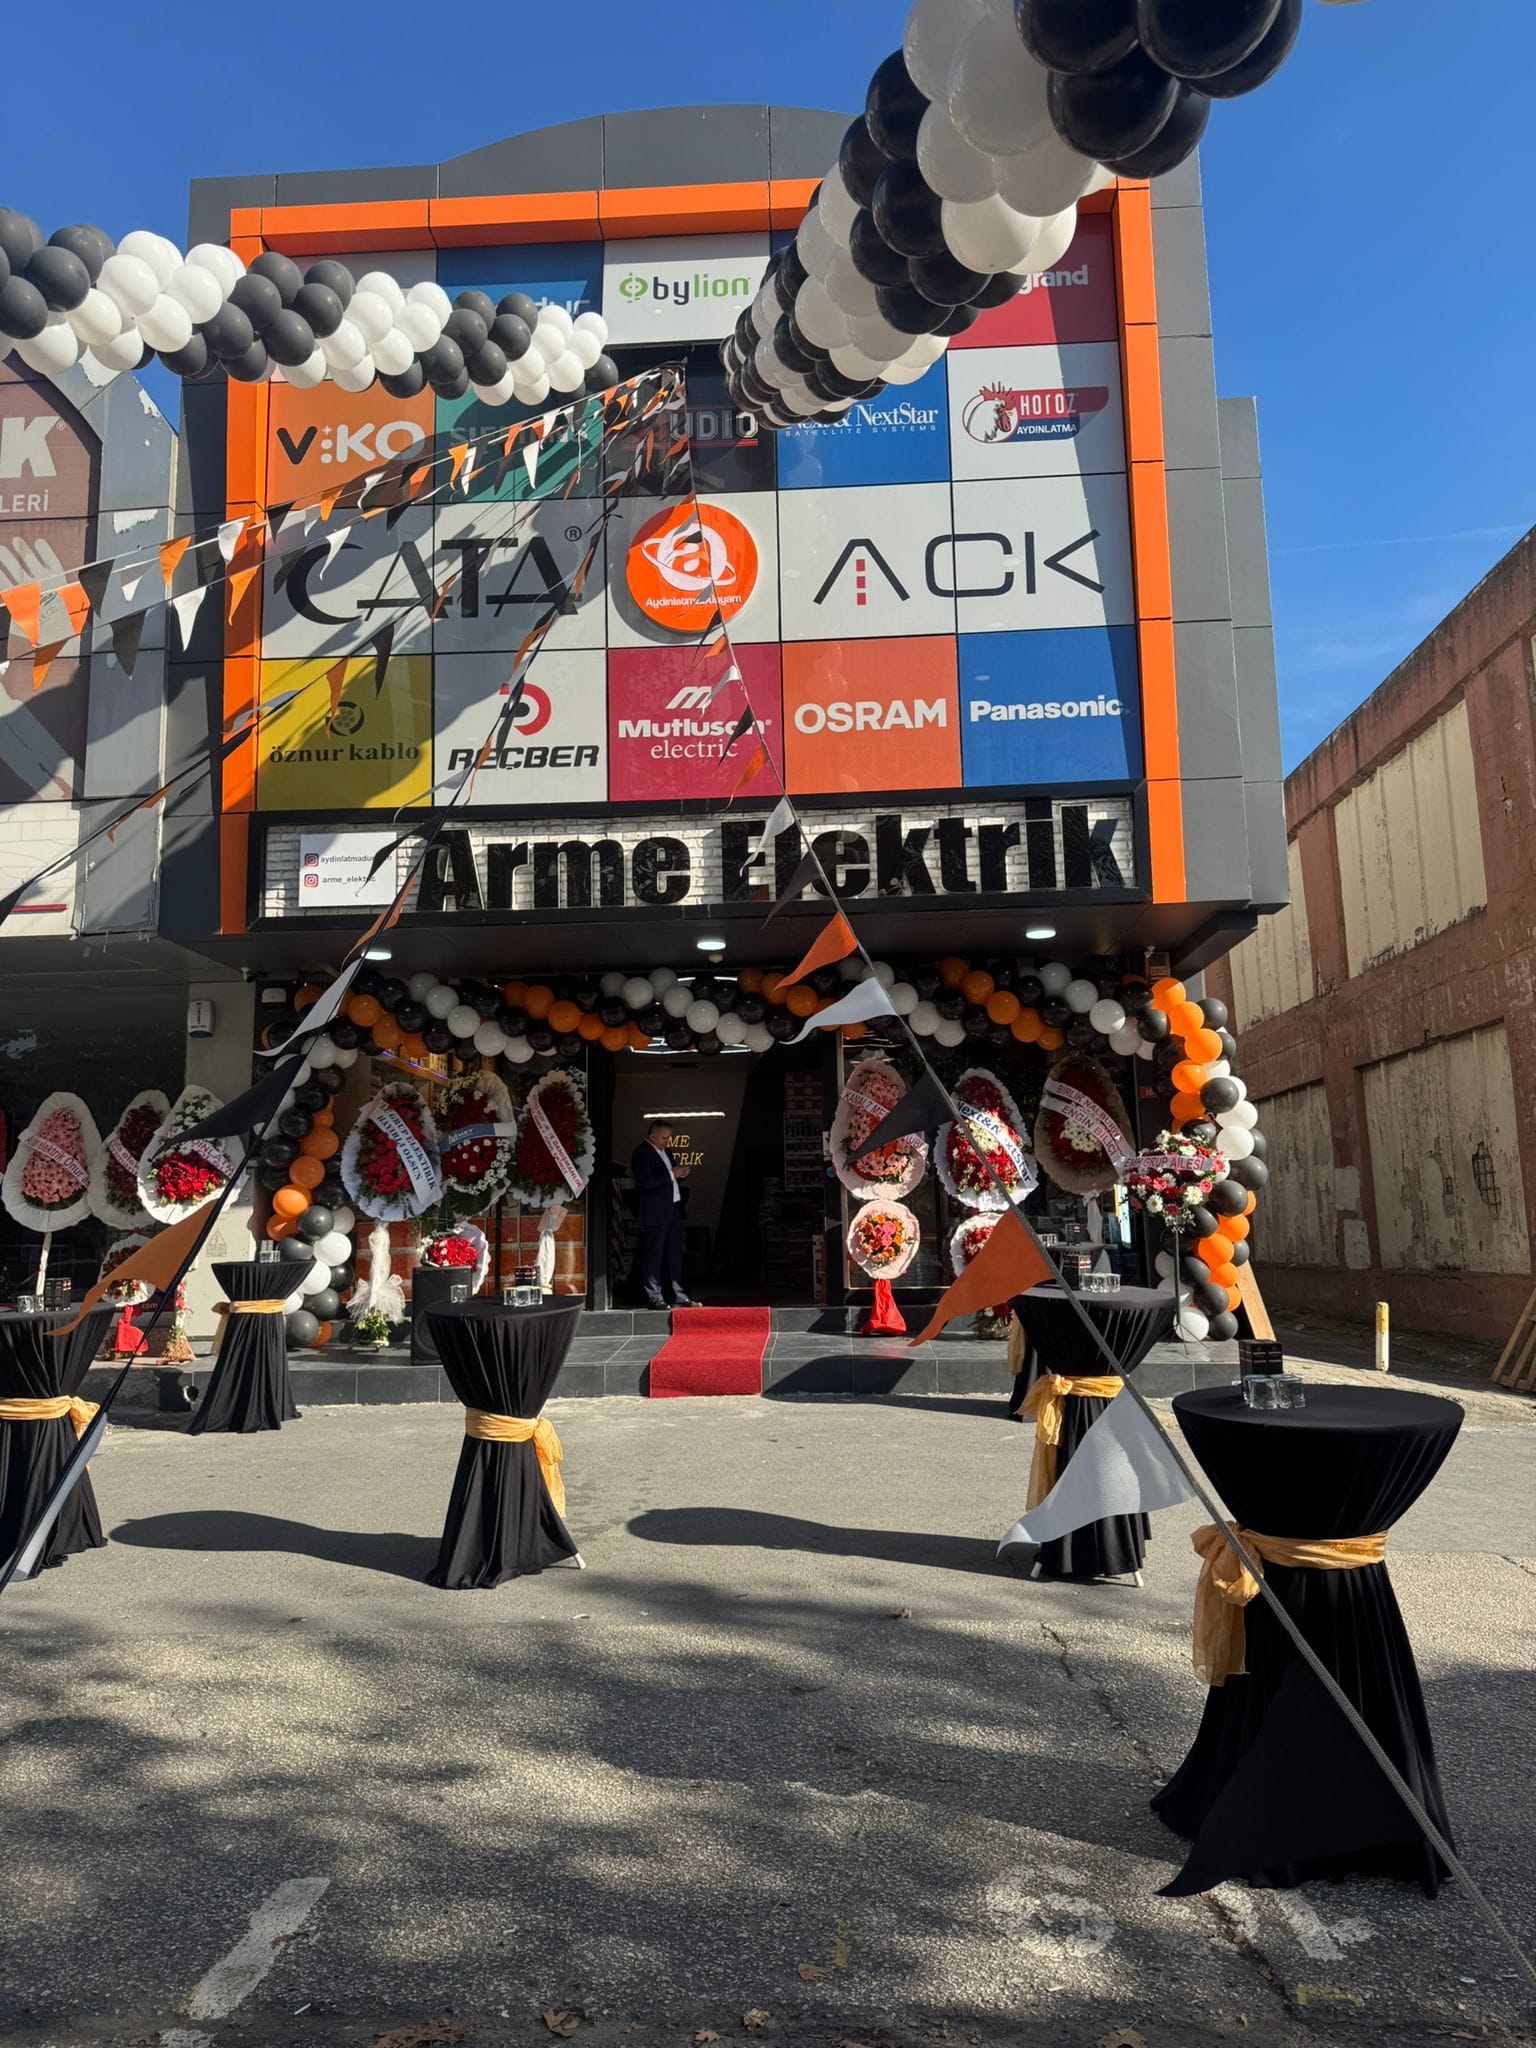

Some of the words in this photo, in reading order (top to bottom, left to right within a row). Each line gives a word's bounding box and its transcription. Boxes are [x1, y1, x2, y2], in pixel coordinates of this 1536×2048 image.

[653, 273, 749, 305] bylion
[1017, 264, 1089, 295] grand
[652, 410, 759, 441] UDIO
[855, 402, 939, 427] NextStar
[1016, 423, 1078, 435] AYDINLATMA
[785, 427, 862, 438] SATELLITE
[872, 424, 937, 434] SYSTEMS
[285, 536, 582, 626] CATA
[813, 529, 1106, 606] ACK
[794, 697, 948, 735] OSRAM
[969, 694, 1124, 723] Panasonic
[269, 745, 345, 764] öznur
[347, 742, 421, 762] kablo
[447, 744, 601, 771] REÇBER
[650, 738, 738, 760] electric
[720, 798, 1126, 903] Elektrik
[415, 828, 692, 912] Arme
[666, 1134, 690, 1148] ME
[402, 1147, 423, 1181] OLSUN
[1143, 1156, 1168, 1168] GRUP
